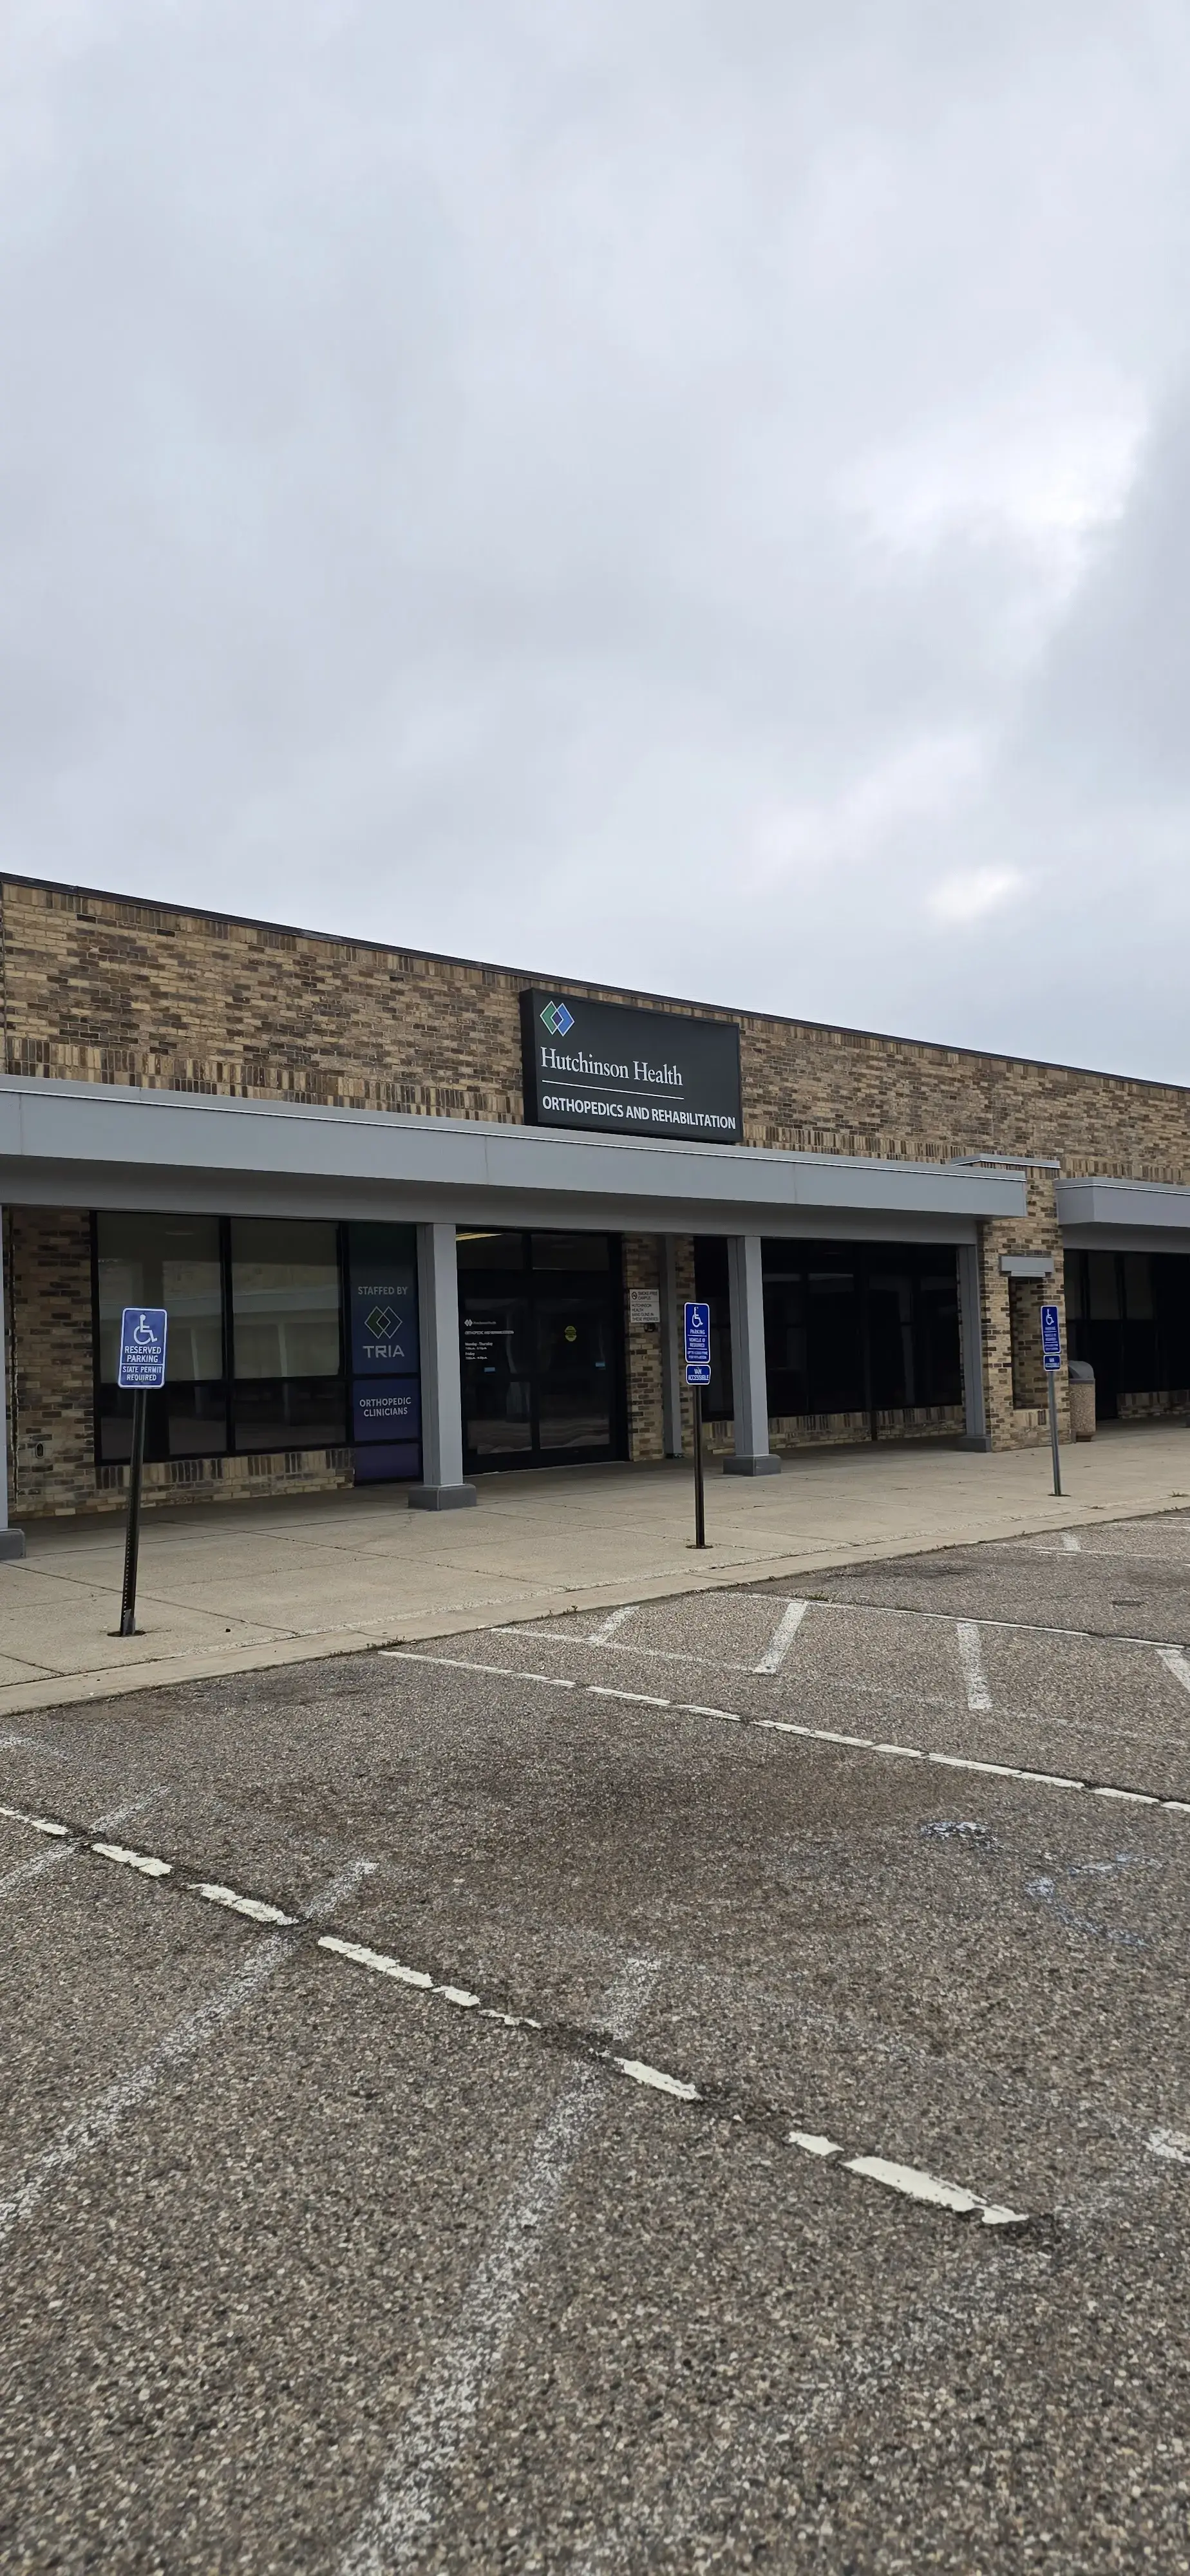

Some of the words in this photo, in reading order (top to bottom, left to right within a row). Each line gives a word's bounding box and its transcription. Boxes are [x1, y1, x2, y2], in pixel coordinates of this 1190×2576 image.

[540, 1046, 629, 1079] Hutchinson
[633, 1060, 683, 1086] Health
[542, 1095, 623, 1117] ORTHOPEDICS
[626, 1106, 649, 1120] AND
[652, 1108, 736, 1130] REHABILITATION
[358, 1287, 394, 1295] STAFFED
[363, 1345, 405, 1358] TRIA
[359, 1396, 411, 1407] ORTHOPEDIC
[363, 1406, 408, 1417] CLINICIANS
